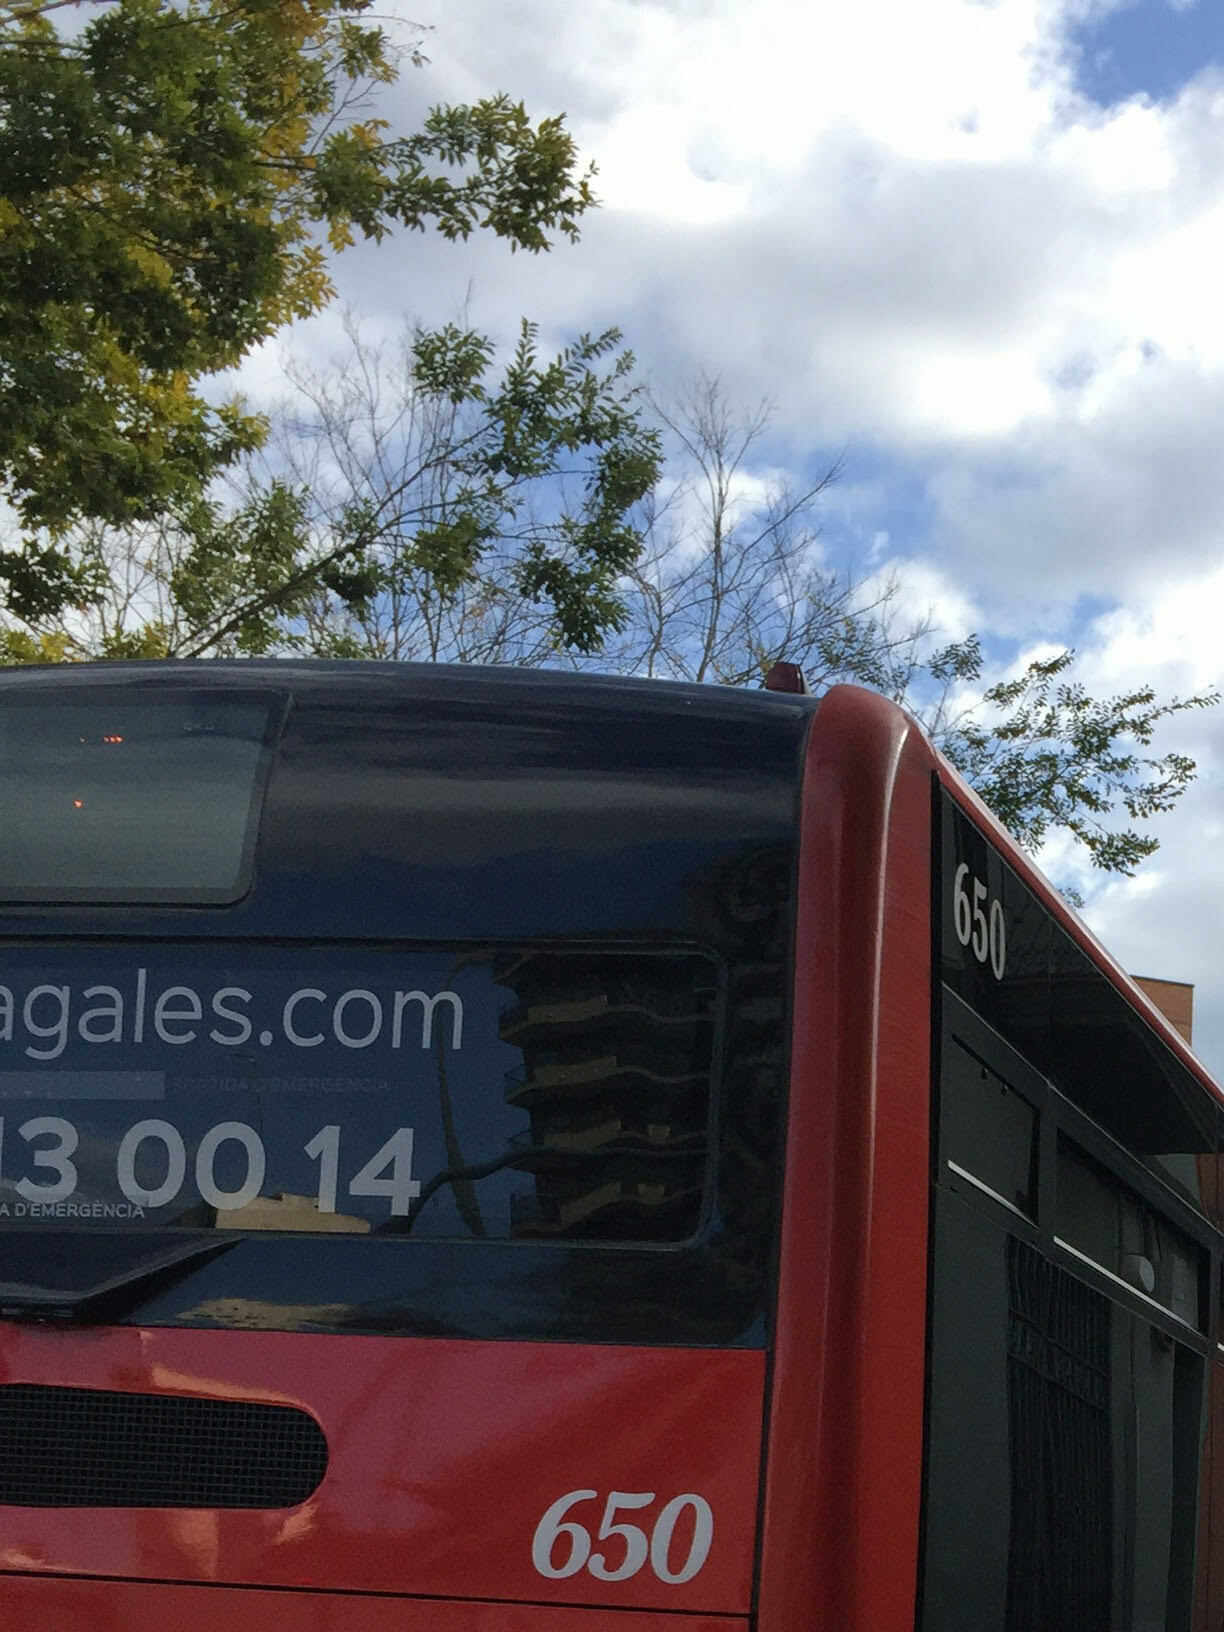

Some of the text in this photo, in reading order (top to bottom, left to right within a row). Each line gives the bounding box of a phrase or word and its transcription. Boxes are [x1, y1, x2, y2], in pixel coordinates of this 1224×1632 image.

[953, 862, 1006, 981] 650
[0, 1115, 422, 1217] 3 00 14
[531, 1489, 714, 1584] 650
